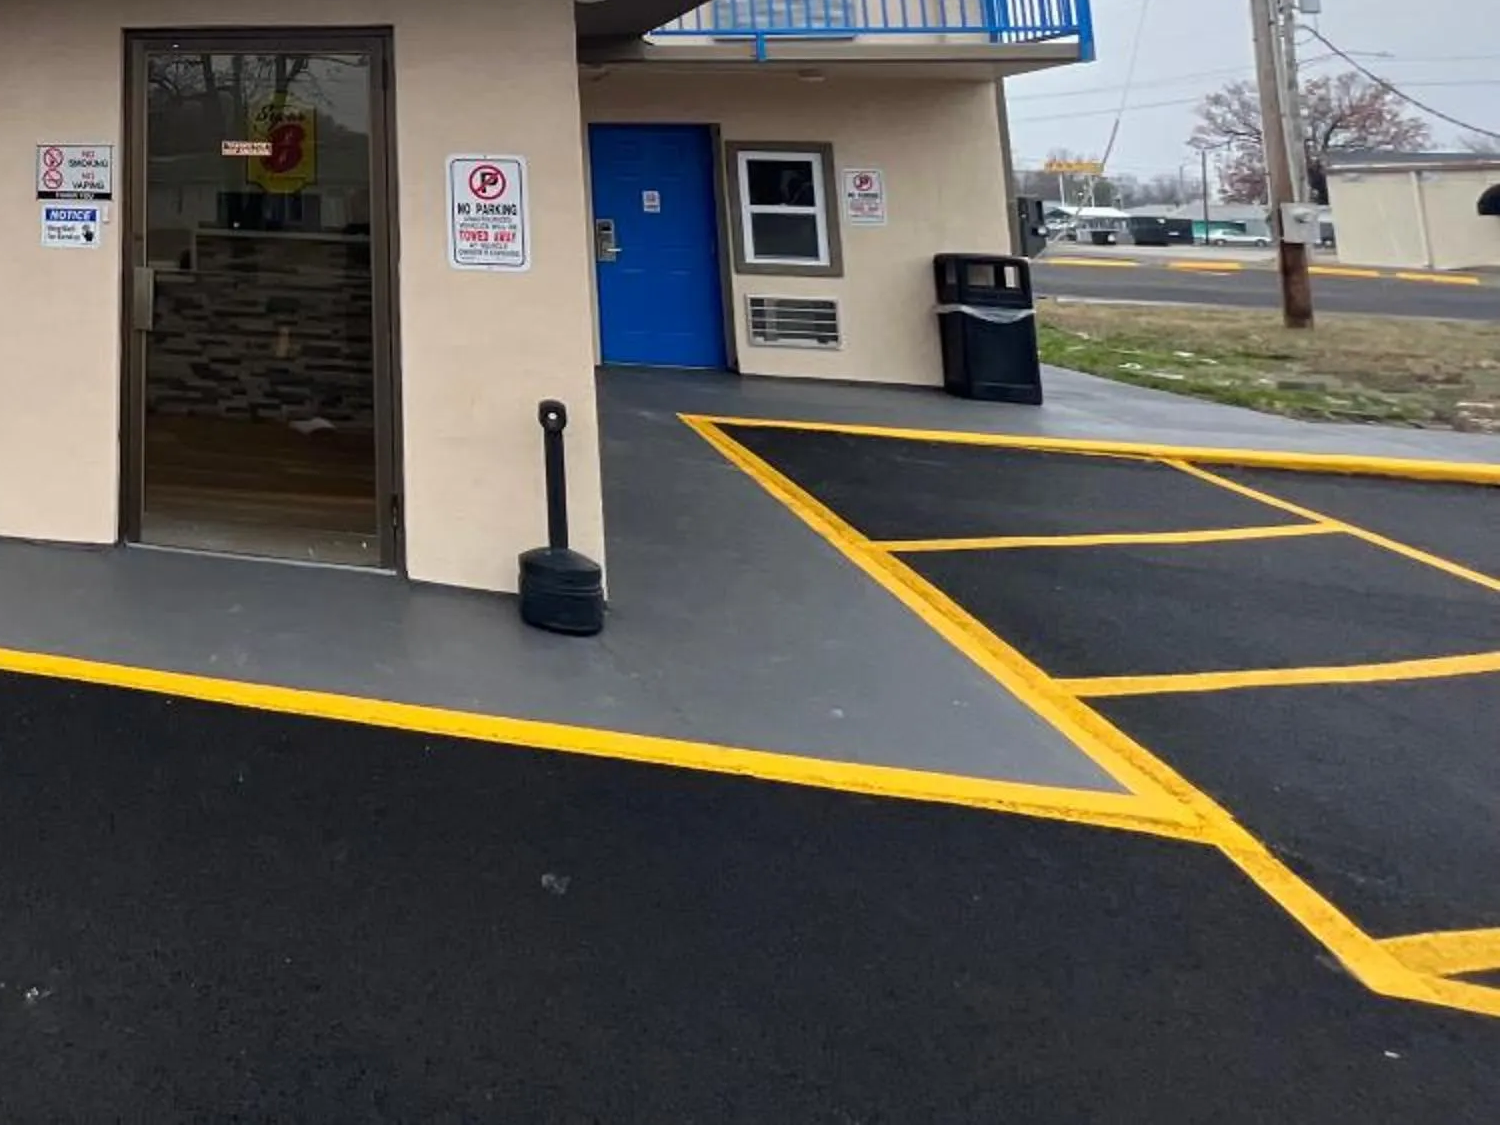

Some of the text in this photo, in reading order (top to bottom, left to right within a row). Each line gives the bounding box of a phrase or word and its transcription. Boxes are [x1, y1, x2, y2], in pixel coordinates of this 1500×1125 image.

[68, 159, 108, 168] SMOKING
[71, 181, 104, 189] VAPING
[457, 203, 517, 216] NO PARKING
[50, 210, 92, 220] NOTICE
[459, 231, 516, 242] TOWED AWAY
